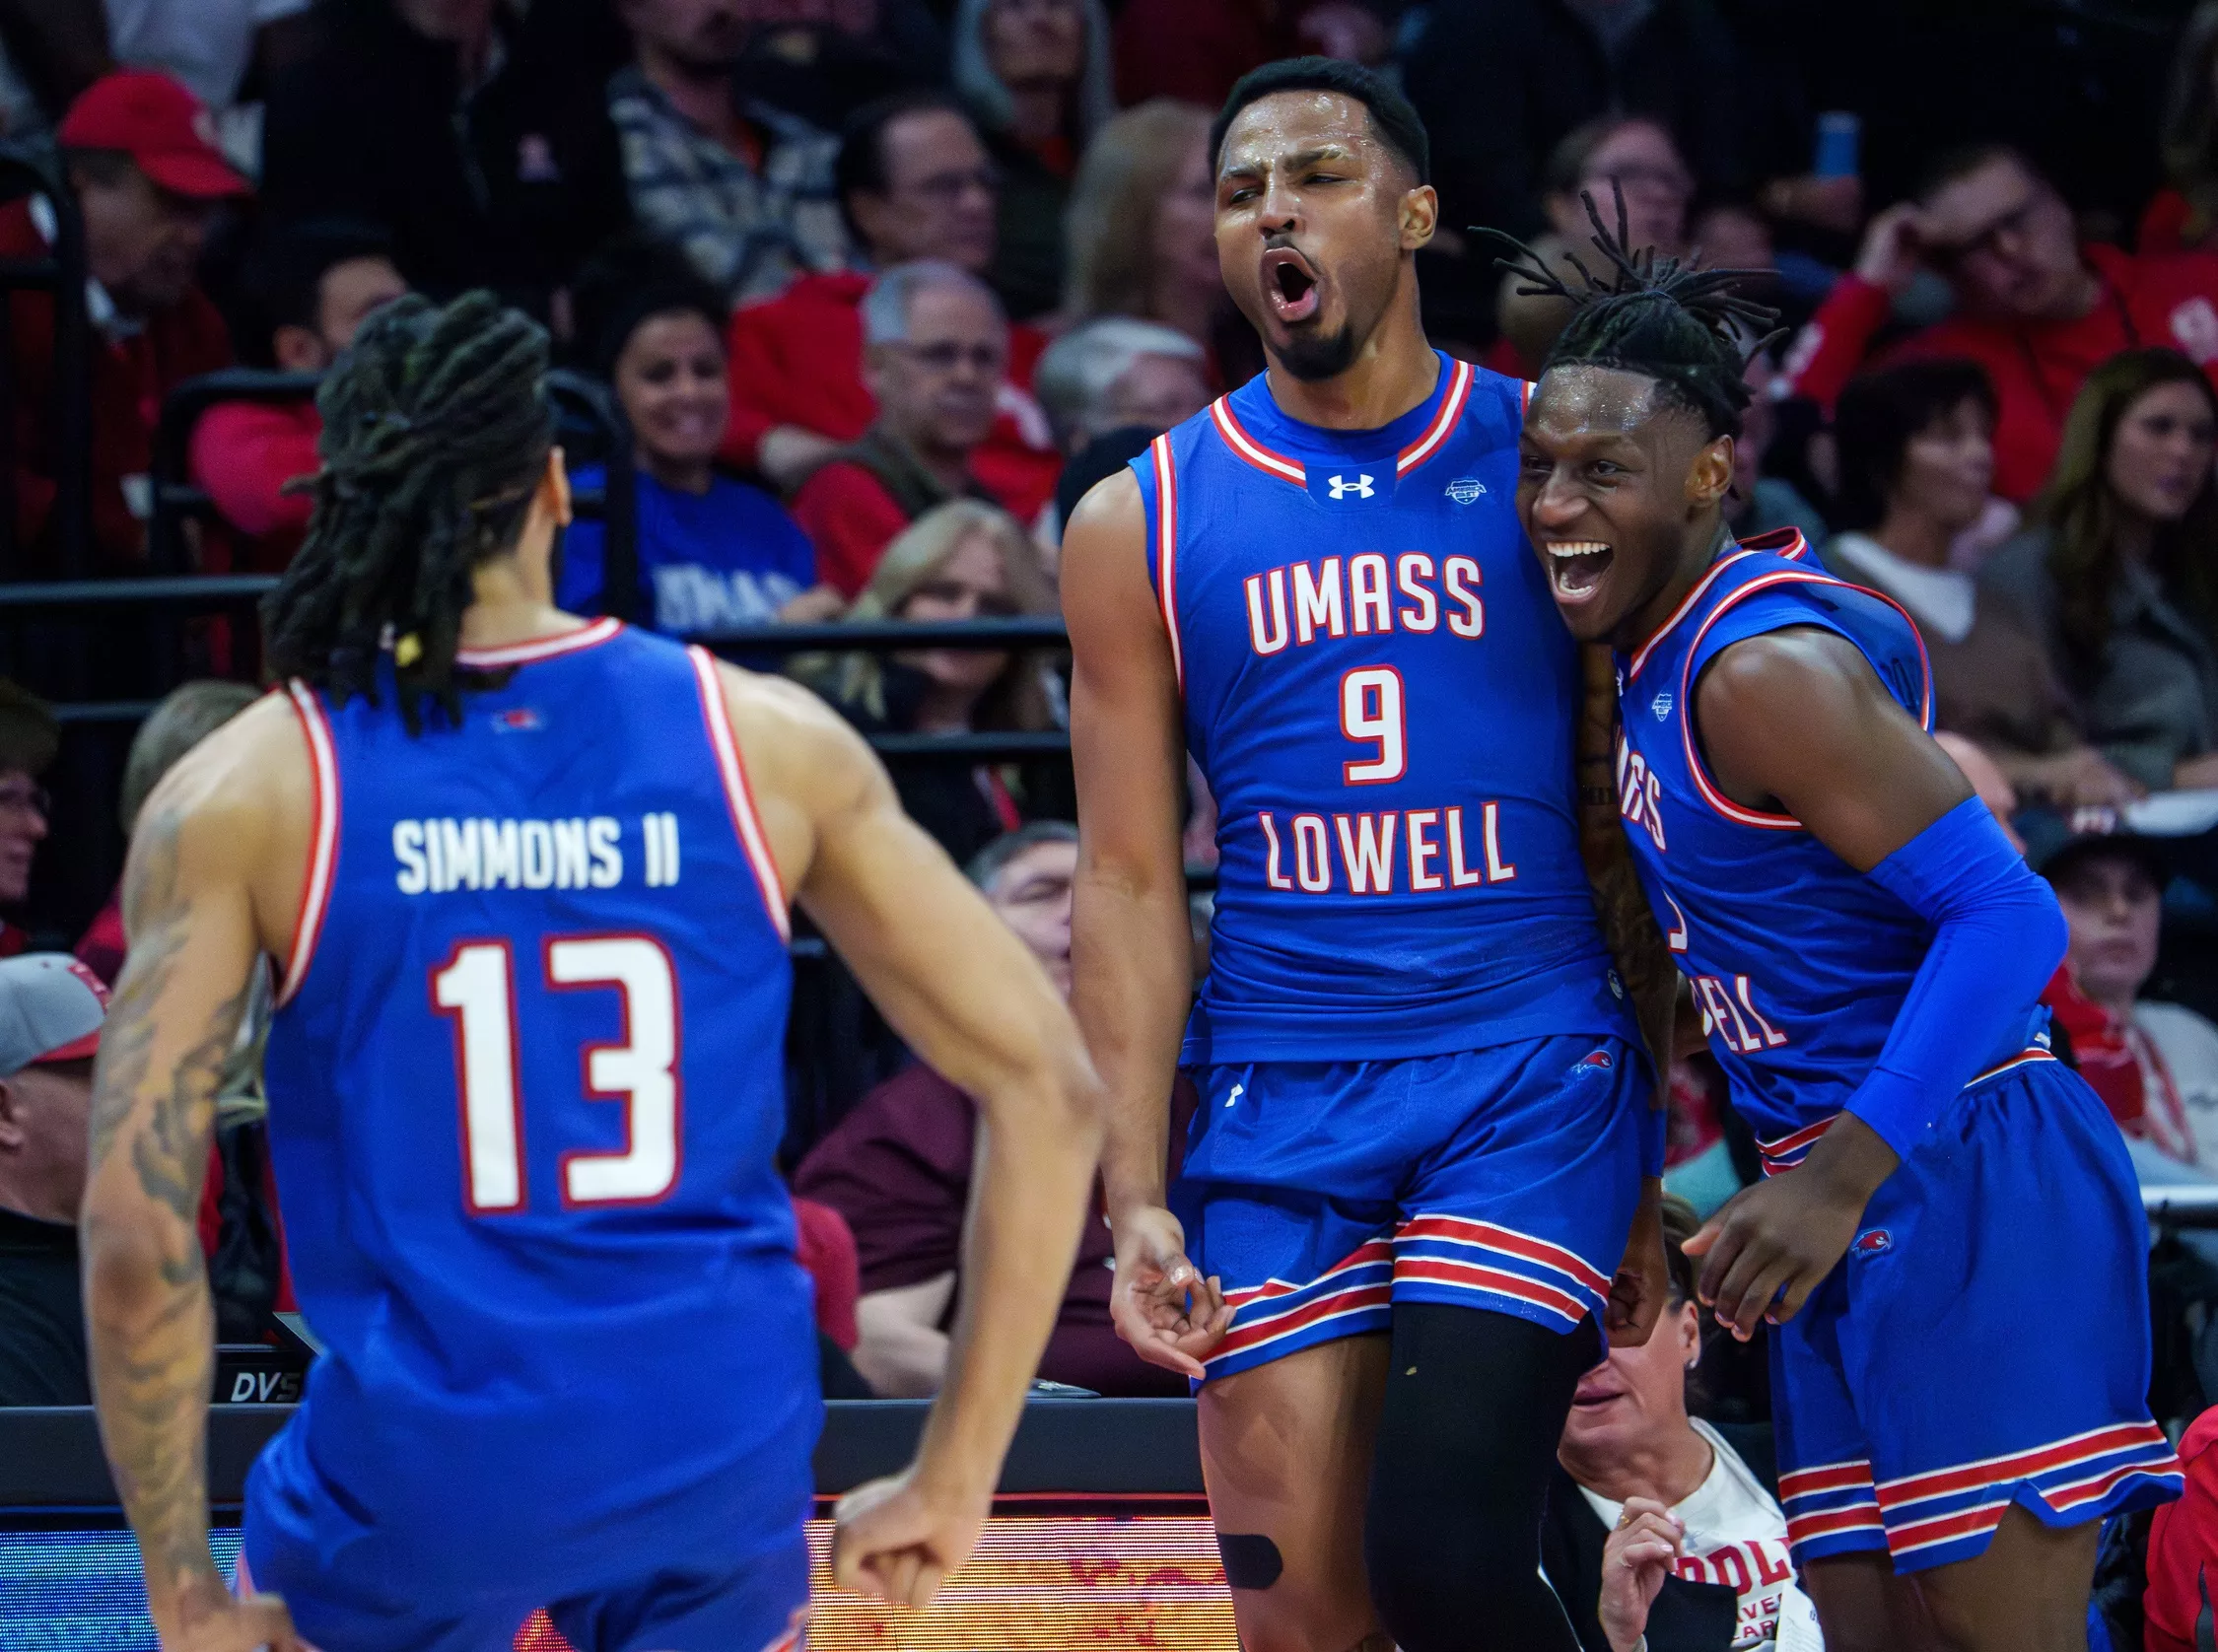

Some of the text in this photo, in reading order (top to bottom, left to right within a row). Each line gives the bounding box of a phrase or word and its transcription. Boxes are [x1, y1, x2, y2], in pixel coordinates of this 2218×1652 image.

[1244, 551, 1486, 657] UMASS
[1339, 663, 1408, 787] 9
[392, 816, 624, 894] SIMMONS
[1259, 800, 1517, 895] LOWELL
[430, 932, 682, 1216] 13
